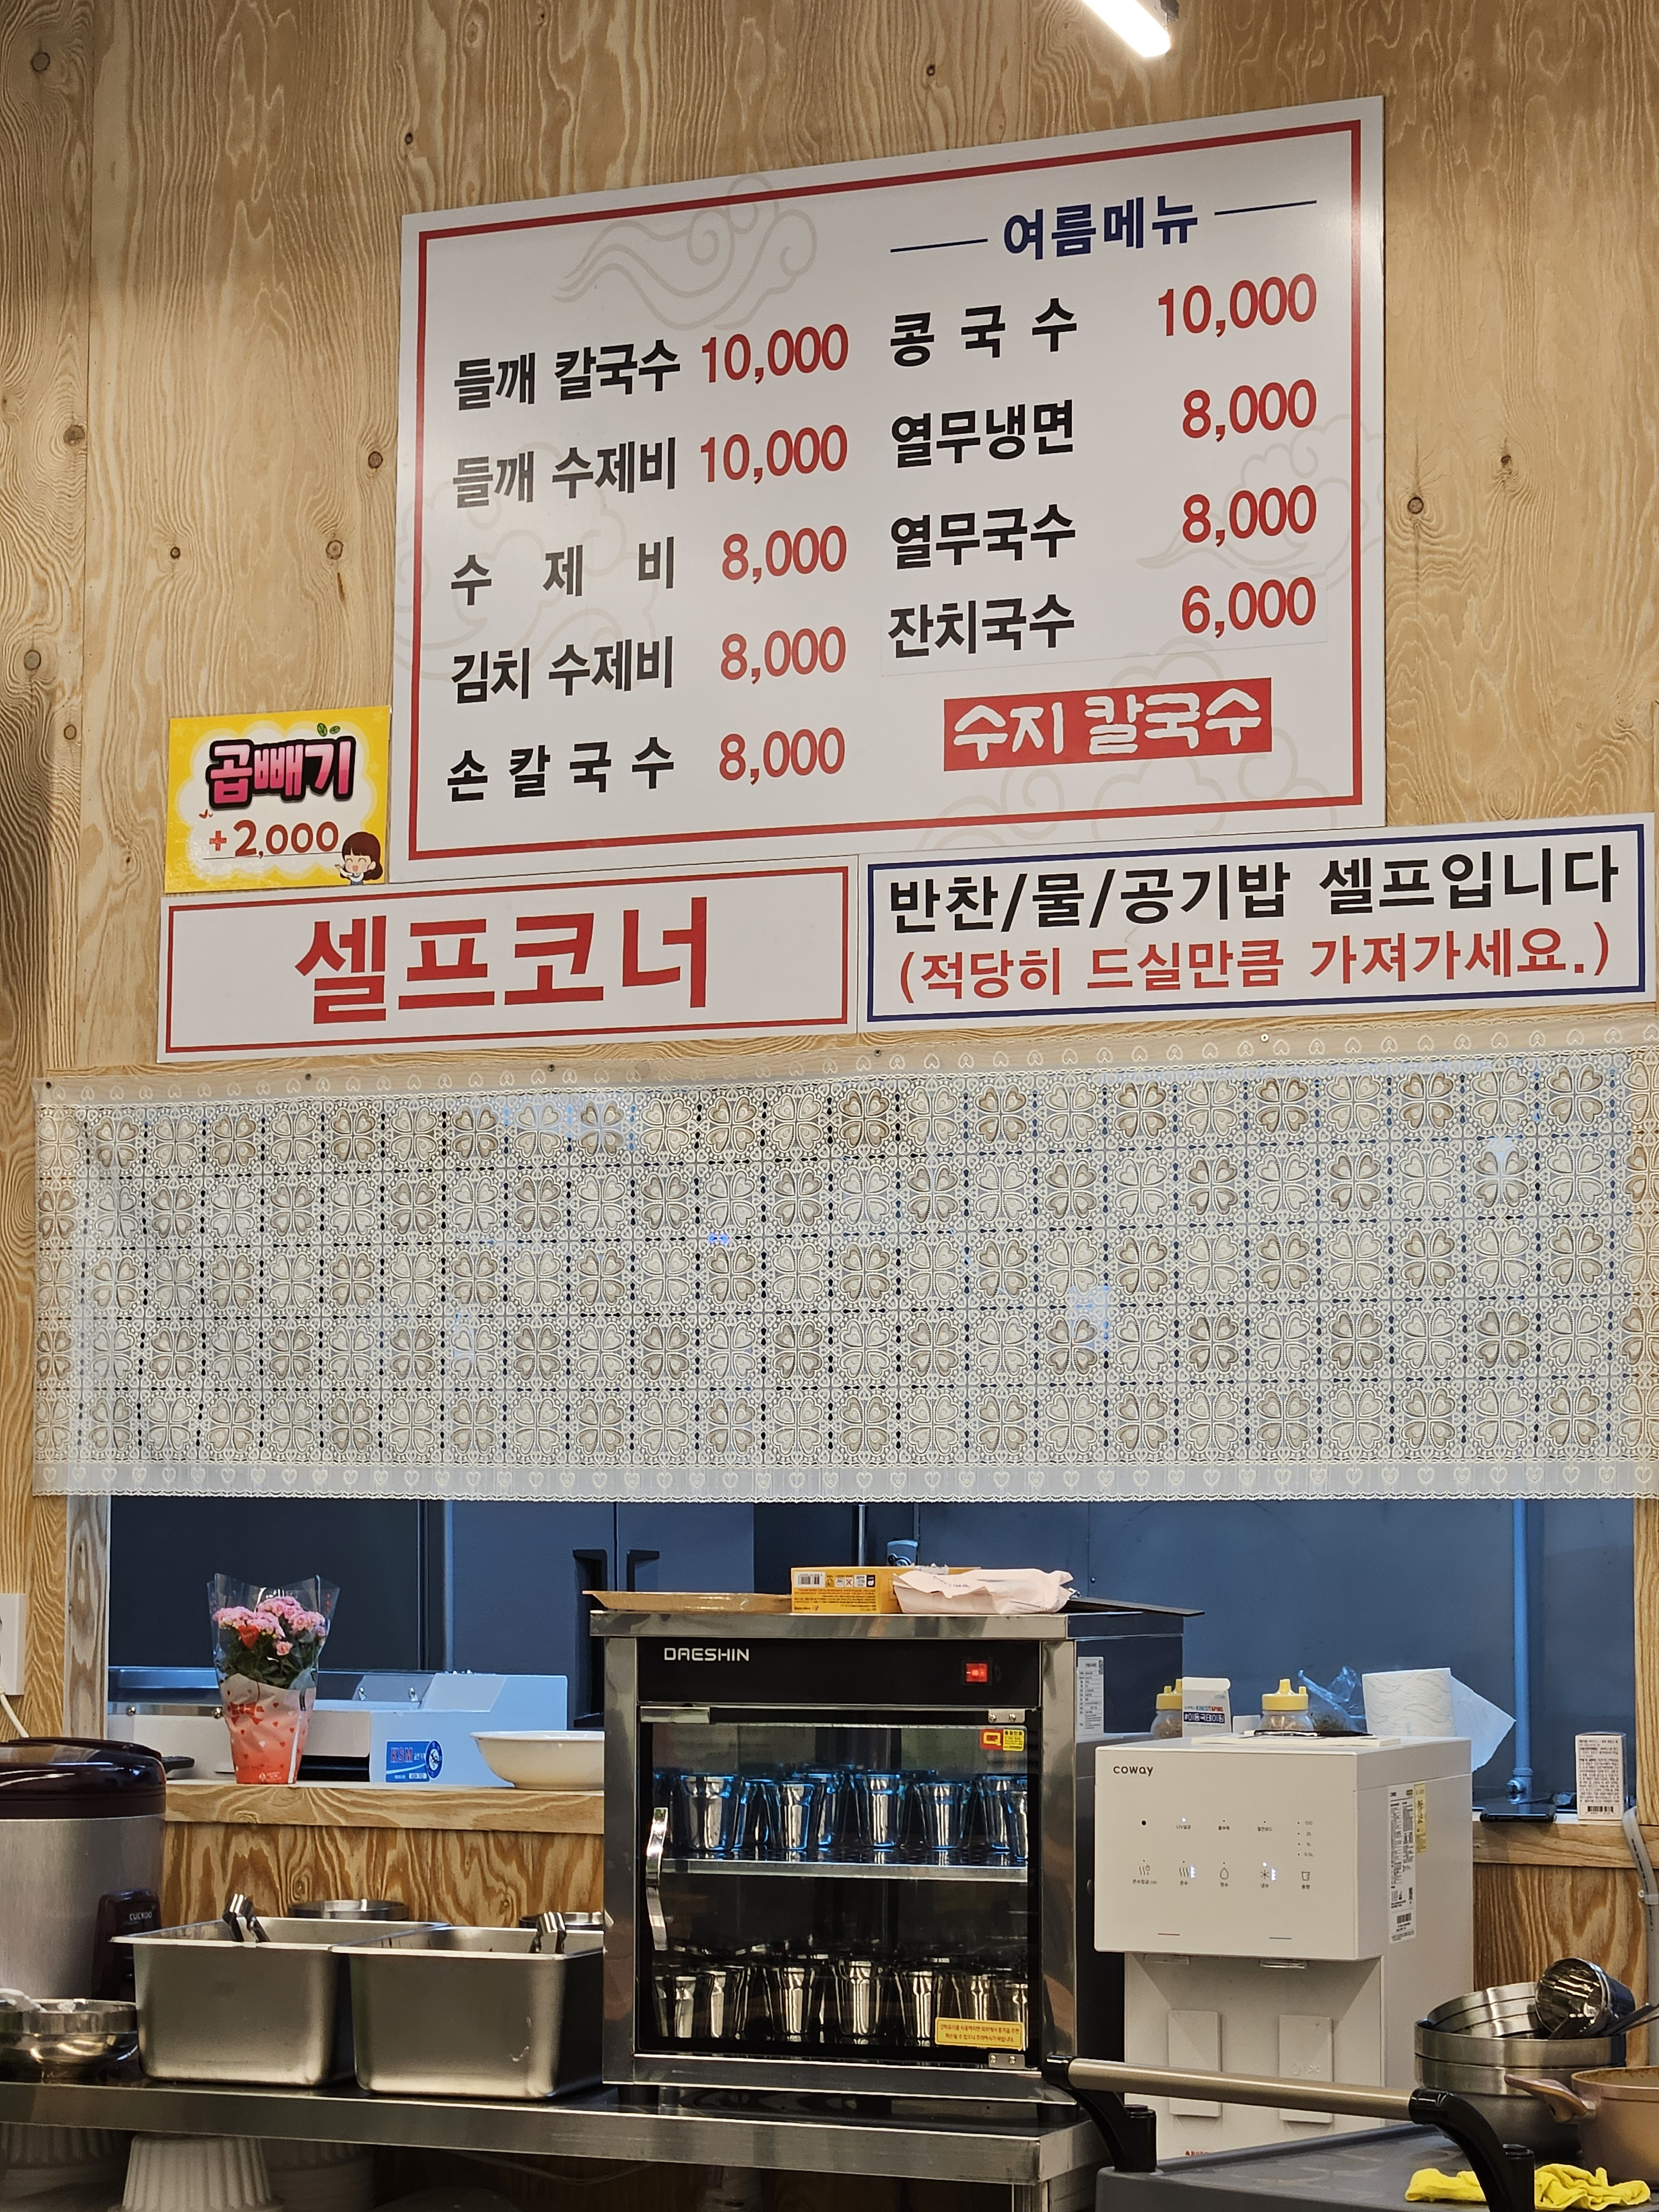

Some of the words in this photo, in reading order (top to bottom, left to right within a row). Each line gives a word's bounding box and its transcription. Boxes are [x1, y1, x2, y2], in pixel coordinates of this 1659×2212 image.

[1004, 195, 1198, 260] 여름메뉴
[1158, 274, 1316, 337] 10,000
[455, 352, 535, 410] 들깨
[555, 340, 680, 400] 칼국수
[702, 324, 848, 384] 10,000
[892, 399, 1073, 468] 열무냉면
[1183, 379, 1316, 441] 8,000
[453, 451, 534, 508] 들깨
[552, 437, 675, 499] 수제비
[701, 425, 847, 484] 10,000
[723, 525, 847, 583] 8,000
[891, 504, 1075, 570] 열무국수
[1182, 485, 1316, 546] 8,000
[888, 594, 1074, 658] 잔치국수
[1182, 577, 1316, 638] 6,000
[451, 648, 529, 703] 김치
[549, 636, 672, 696] 수제비
[721, 627, 846, 684] 8,000
[719, 727, 845, 784] 8,000
[953, 702, 1064, 762] 수지
[1084, 687, 1262, 755] 칼국수
[207, 737, 354, 808] 곱빼기
[890, 860, 1290, 933] 반찬/물/공기밥
[1319, 844, 1619, 915] 셀프입니다
[295, 896, 707, 1024] 셀프코너
[900, 947, 1060, 1004] (적당히
[1087, 939, 1284, 991] 드실만큼
[1310, 921, 1609, 984] 가져가세요.)
[664, 1647, 749, 1661] DAESHIN
[390, 1747, 413, 1763] KSM
[1113, 1766, 1153, 1777] coway
[129, 1911, 152, 1921] CUCKOO
